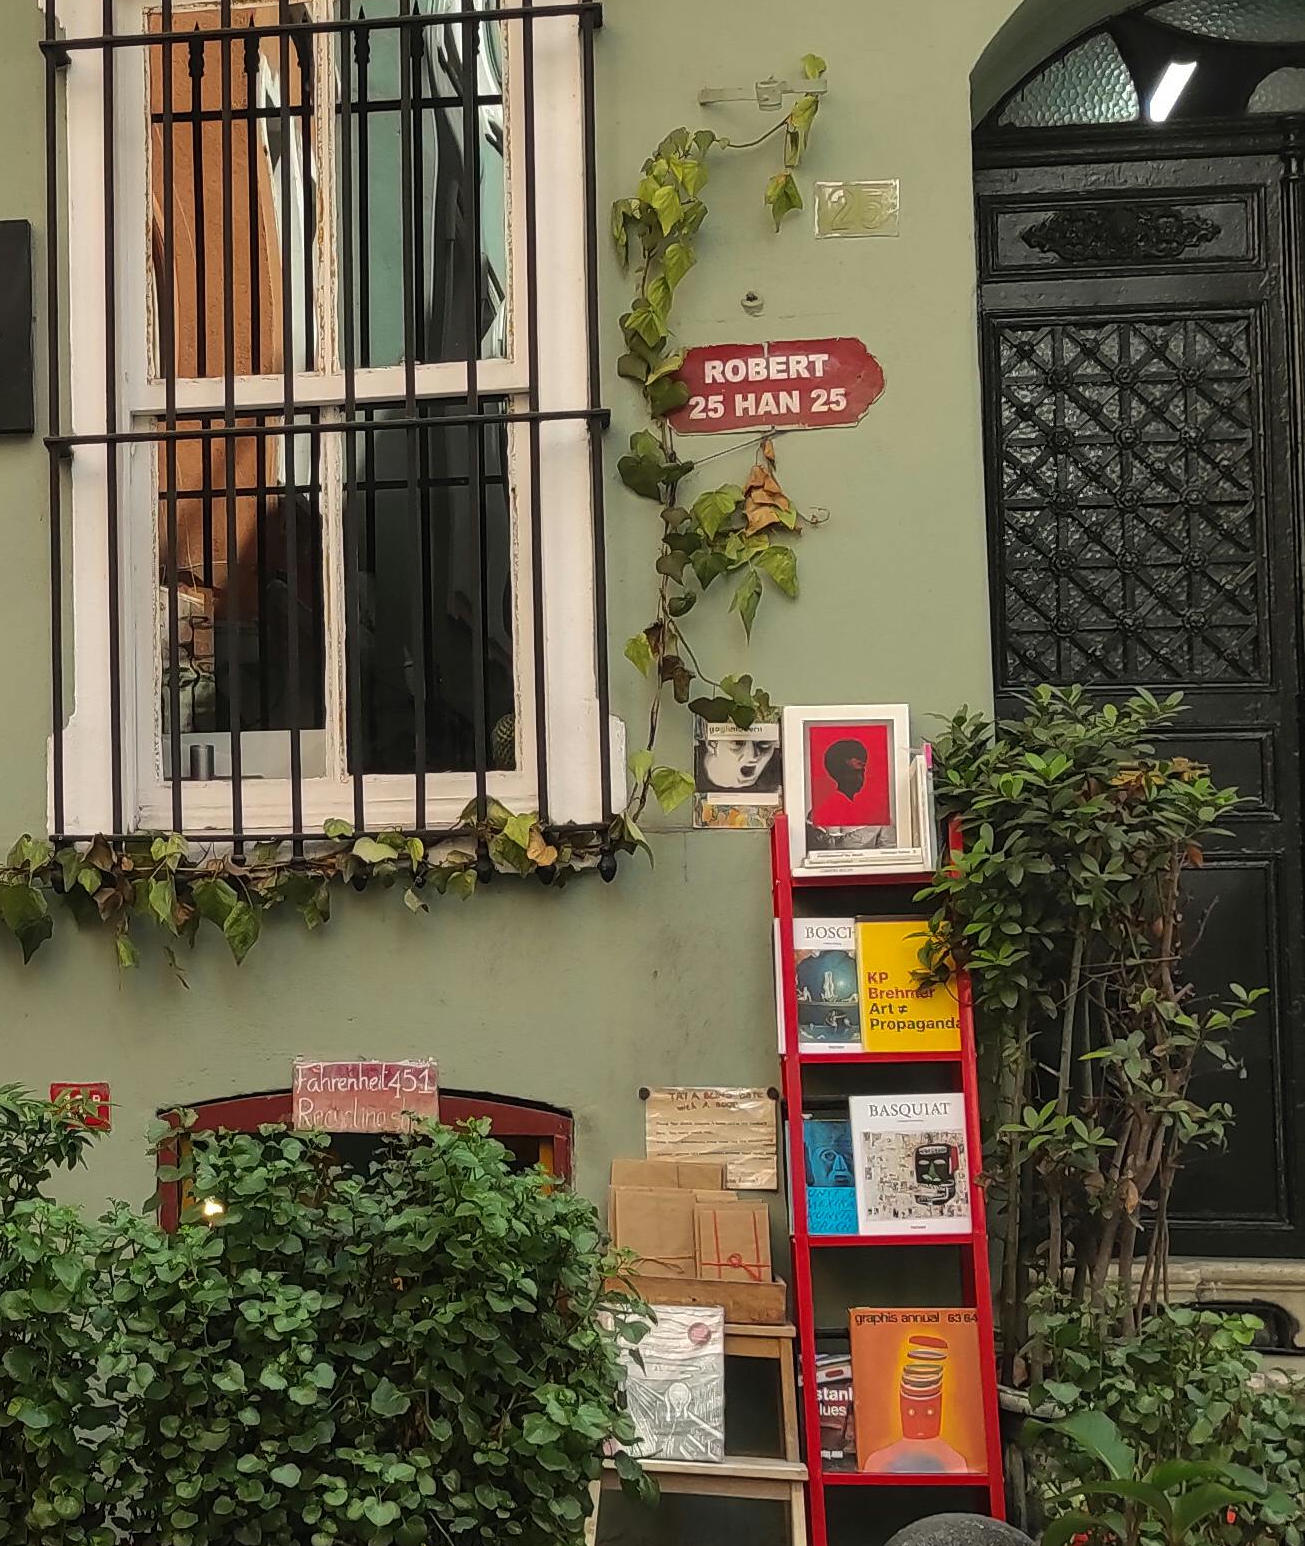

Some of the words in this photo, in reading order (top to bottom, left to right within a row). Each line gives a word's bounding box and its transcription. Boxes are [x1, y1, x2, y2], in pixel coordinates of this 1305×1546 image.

[704, 353, 829, 384] ROBERT
[688, 395, 725, 420] 25
[734, 390, 801, 417] HAN
[810, 387, 847, 413] 25
[867, 971, 889, 985] KP
[869, 1003, 894, 1015] Art
[388, 1068, 434, 1099] 451
[869, 1102, 951, 1118] BASQUIAT
[855, 1312, 898, 1326] graphis
[901, 1312, 940, 1324] annual
[819, 1402, 847, 1416] lues
